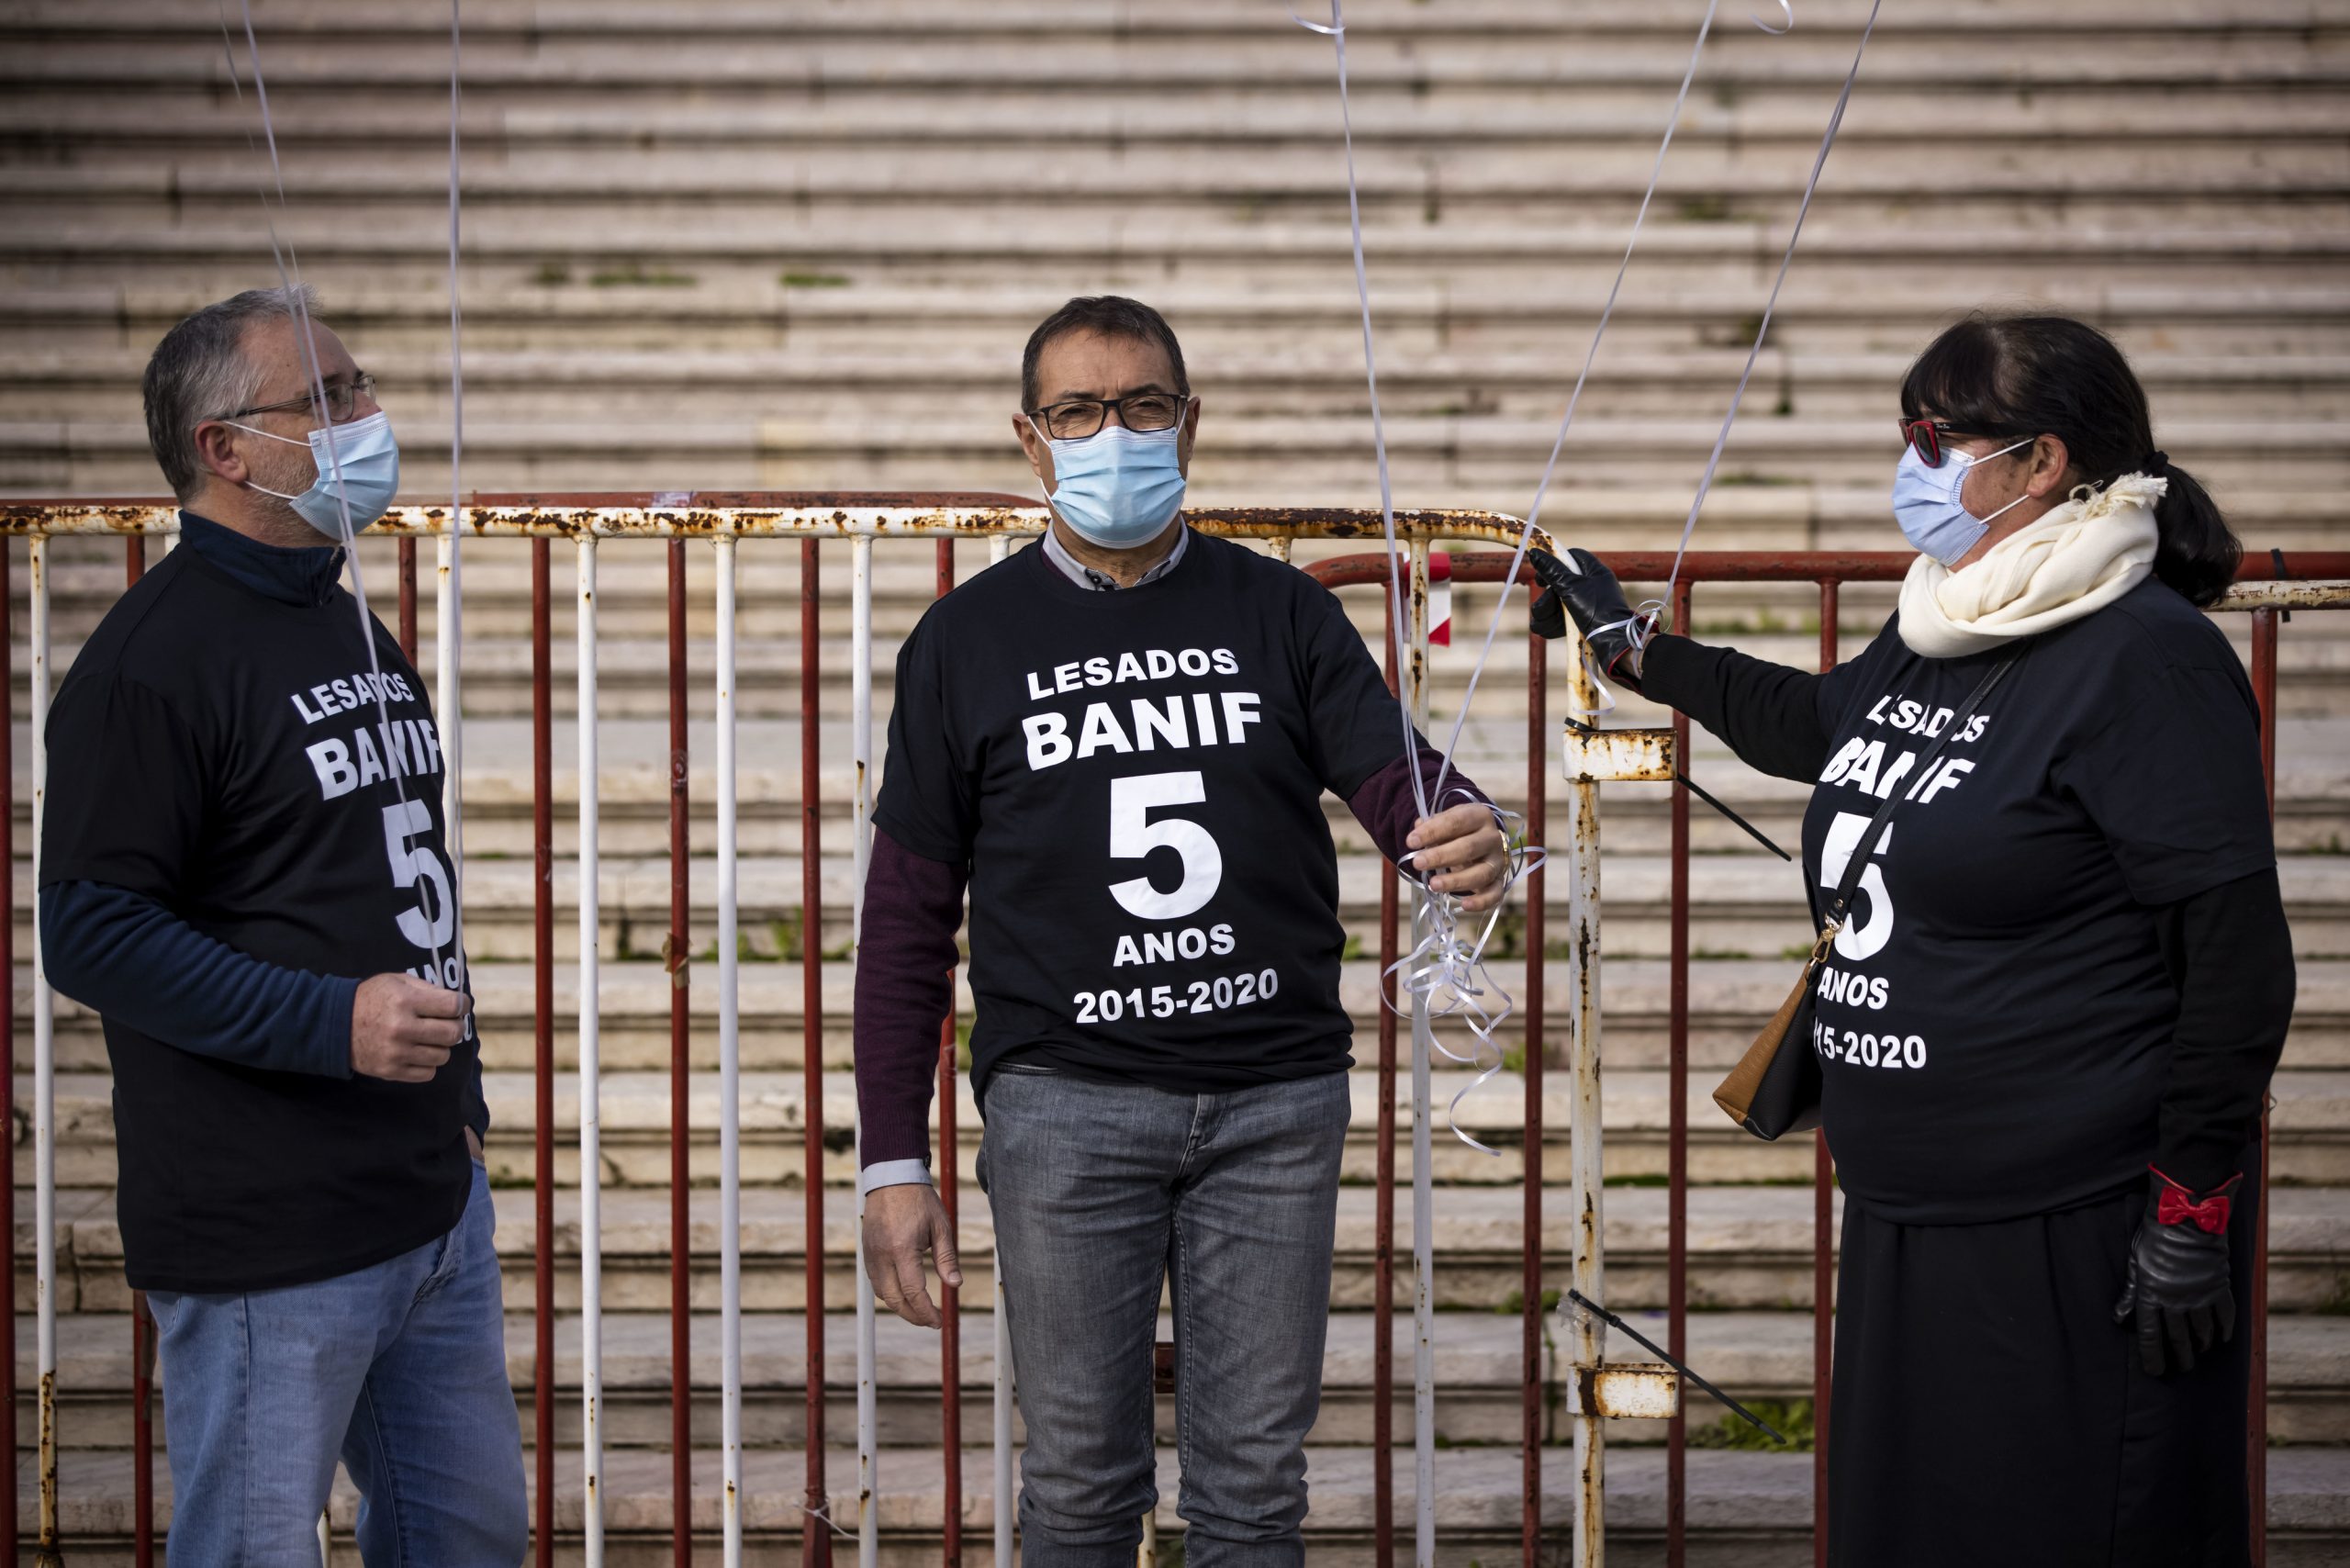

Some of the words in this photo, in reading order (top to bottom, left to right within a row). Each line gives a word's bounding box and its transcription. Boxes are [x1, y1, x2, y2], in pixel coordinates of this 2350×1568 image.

[291, 672, 415, 725] LESADOS
[1027, 648, 1239, 701] LESADOS
[1022, 692, 1261, 772] BANIF
[1865, 694, 1991, 743] LSADS
[306, 719, 440, 801] BANIF
[1109, 771, 1223, 921] 5
[382, 799, 454, 949] 5
[1820, 812, 1895, 961] 5
[1113, 924, 1236, 968] ANOS
[1074, 969, 1279, 1025] 2015-2020
[1818, 966, 1889, 1010] ANOS
[1814, 1015, 1927, 1070] 15-2020
